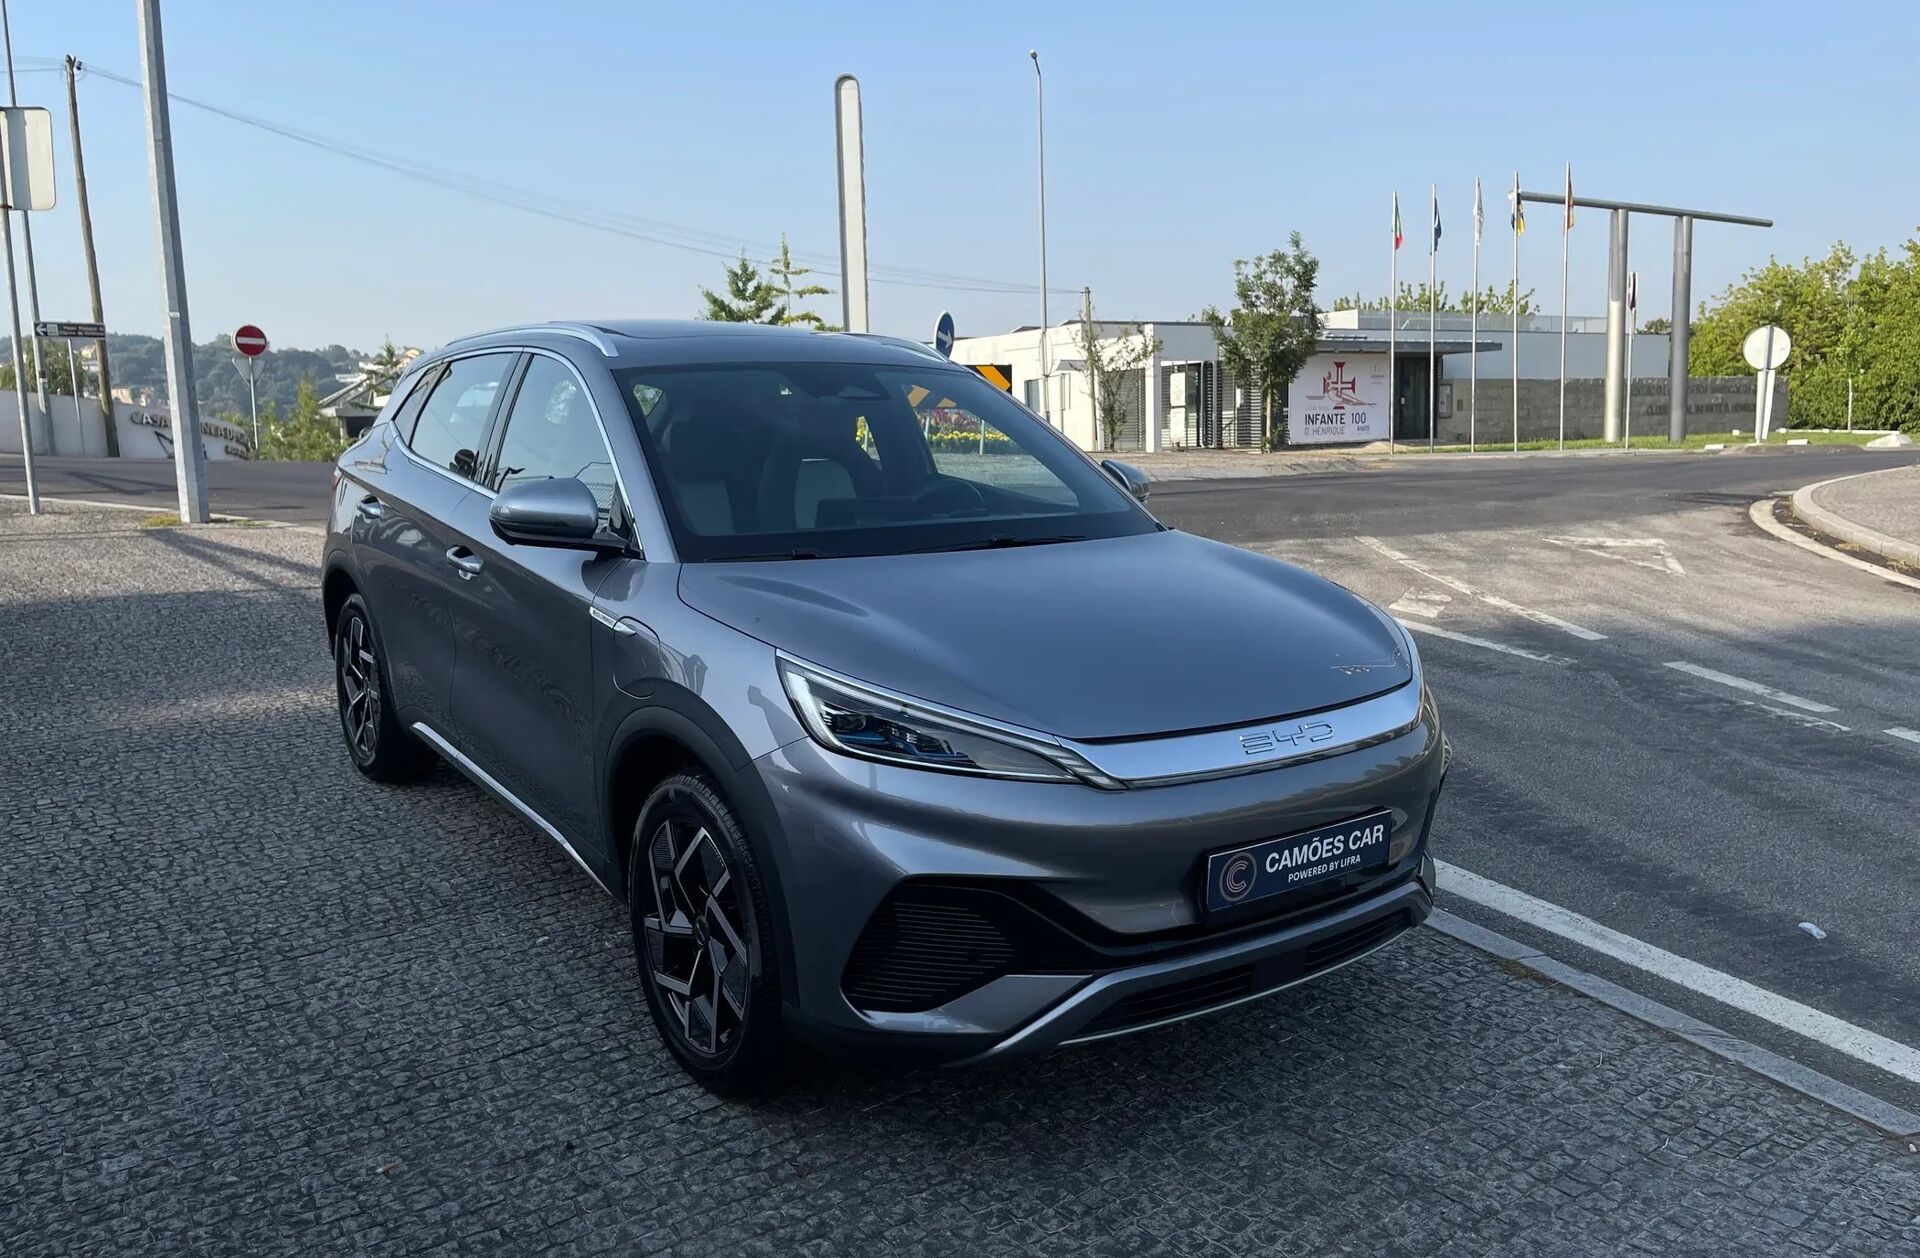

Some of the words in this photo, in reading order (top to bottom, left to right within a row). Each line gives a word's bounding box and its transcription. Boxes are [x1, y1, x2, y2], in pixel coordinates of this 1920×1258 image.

[1305, 413, 1345, 425] INFANTE
[1351, 412, 1366, 424] 100
[1312, 426, 1345, 436] HENRIQUE
[1240, 721, 1335, 755] BYD
[1265, 836, 1344, 873] CAMÕES
[1348, 824, 1384, 850] CAR
[1288, 863, 1328, 882] POWERED
[1329, 861, 1340, 872] BY
[1340, 854, 1361, 868] LIFRA
